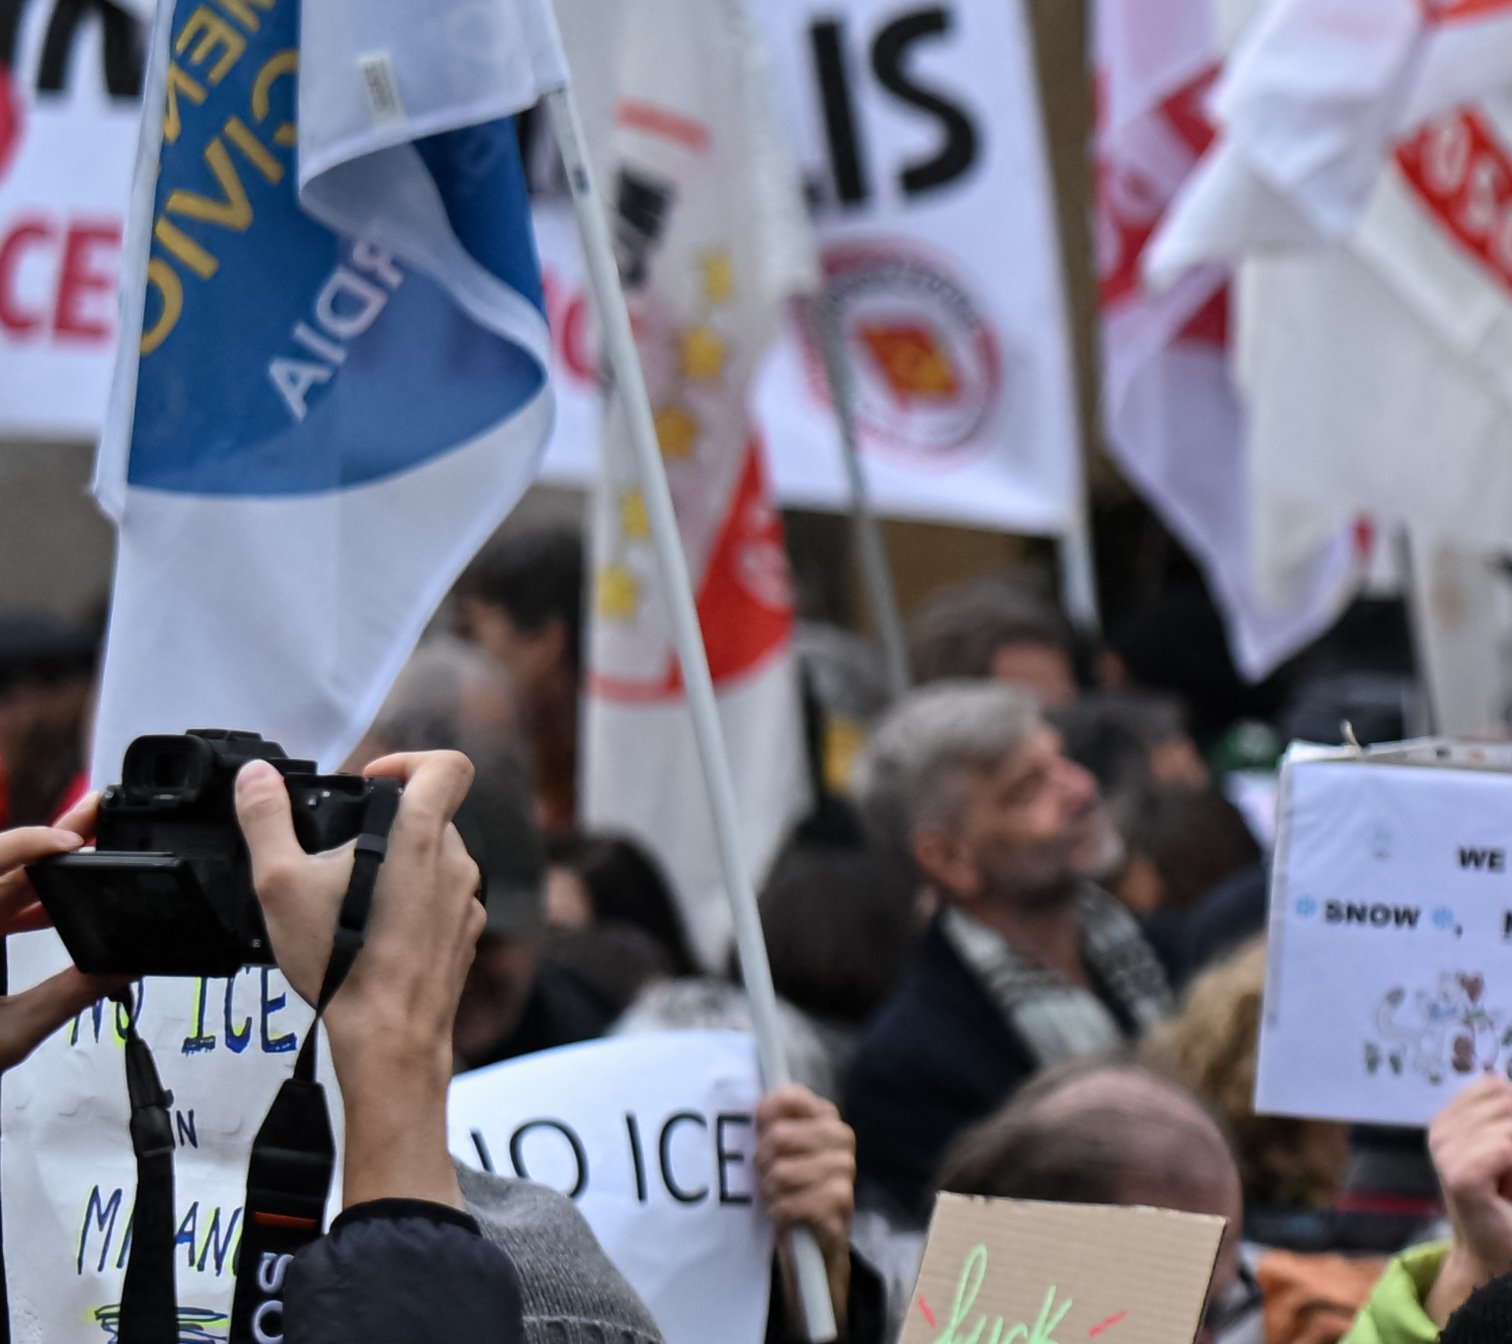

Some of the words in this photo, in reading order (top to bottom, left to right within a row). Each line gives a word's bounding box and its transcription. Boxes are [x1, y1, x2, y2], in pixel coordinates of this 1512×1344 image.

[803, 0, 985, 206] IS
[1457, 846, 1505, 873] WE
[1324, 900, 1420, 928] SNOW
[182, 966, 298, 1054] ICE
[624, 1110, 753, 1205] ICE
